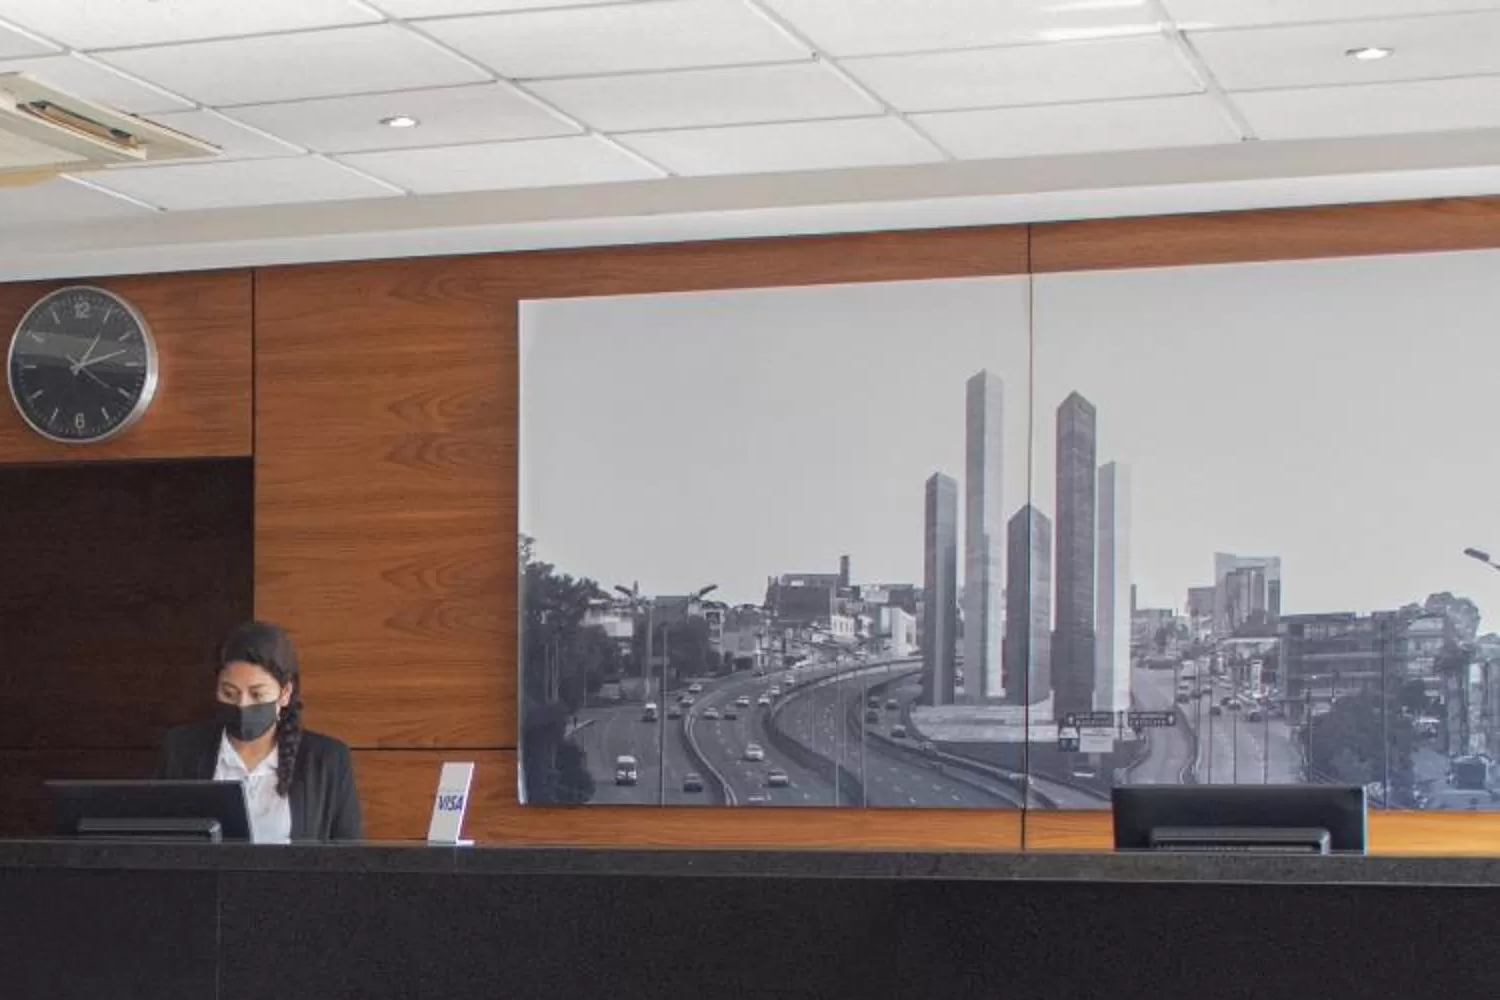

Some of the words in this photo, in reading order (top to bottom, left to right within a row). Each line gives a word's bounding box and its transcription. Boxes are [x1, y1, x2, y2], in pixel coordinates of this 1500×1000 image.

[74, 302, 90, 318] 12
[75, 413, 84, 428] 6
[439, 795, 463, 811] VISA
